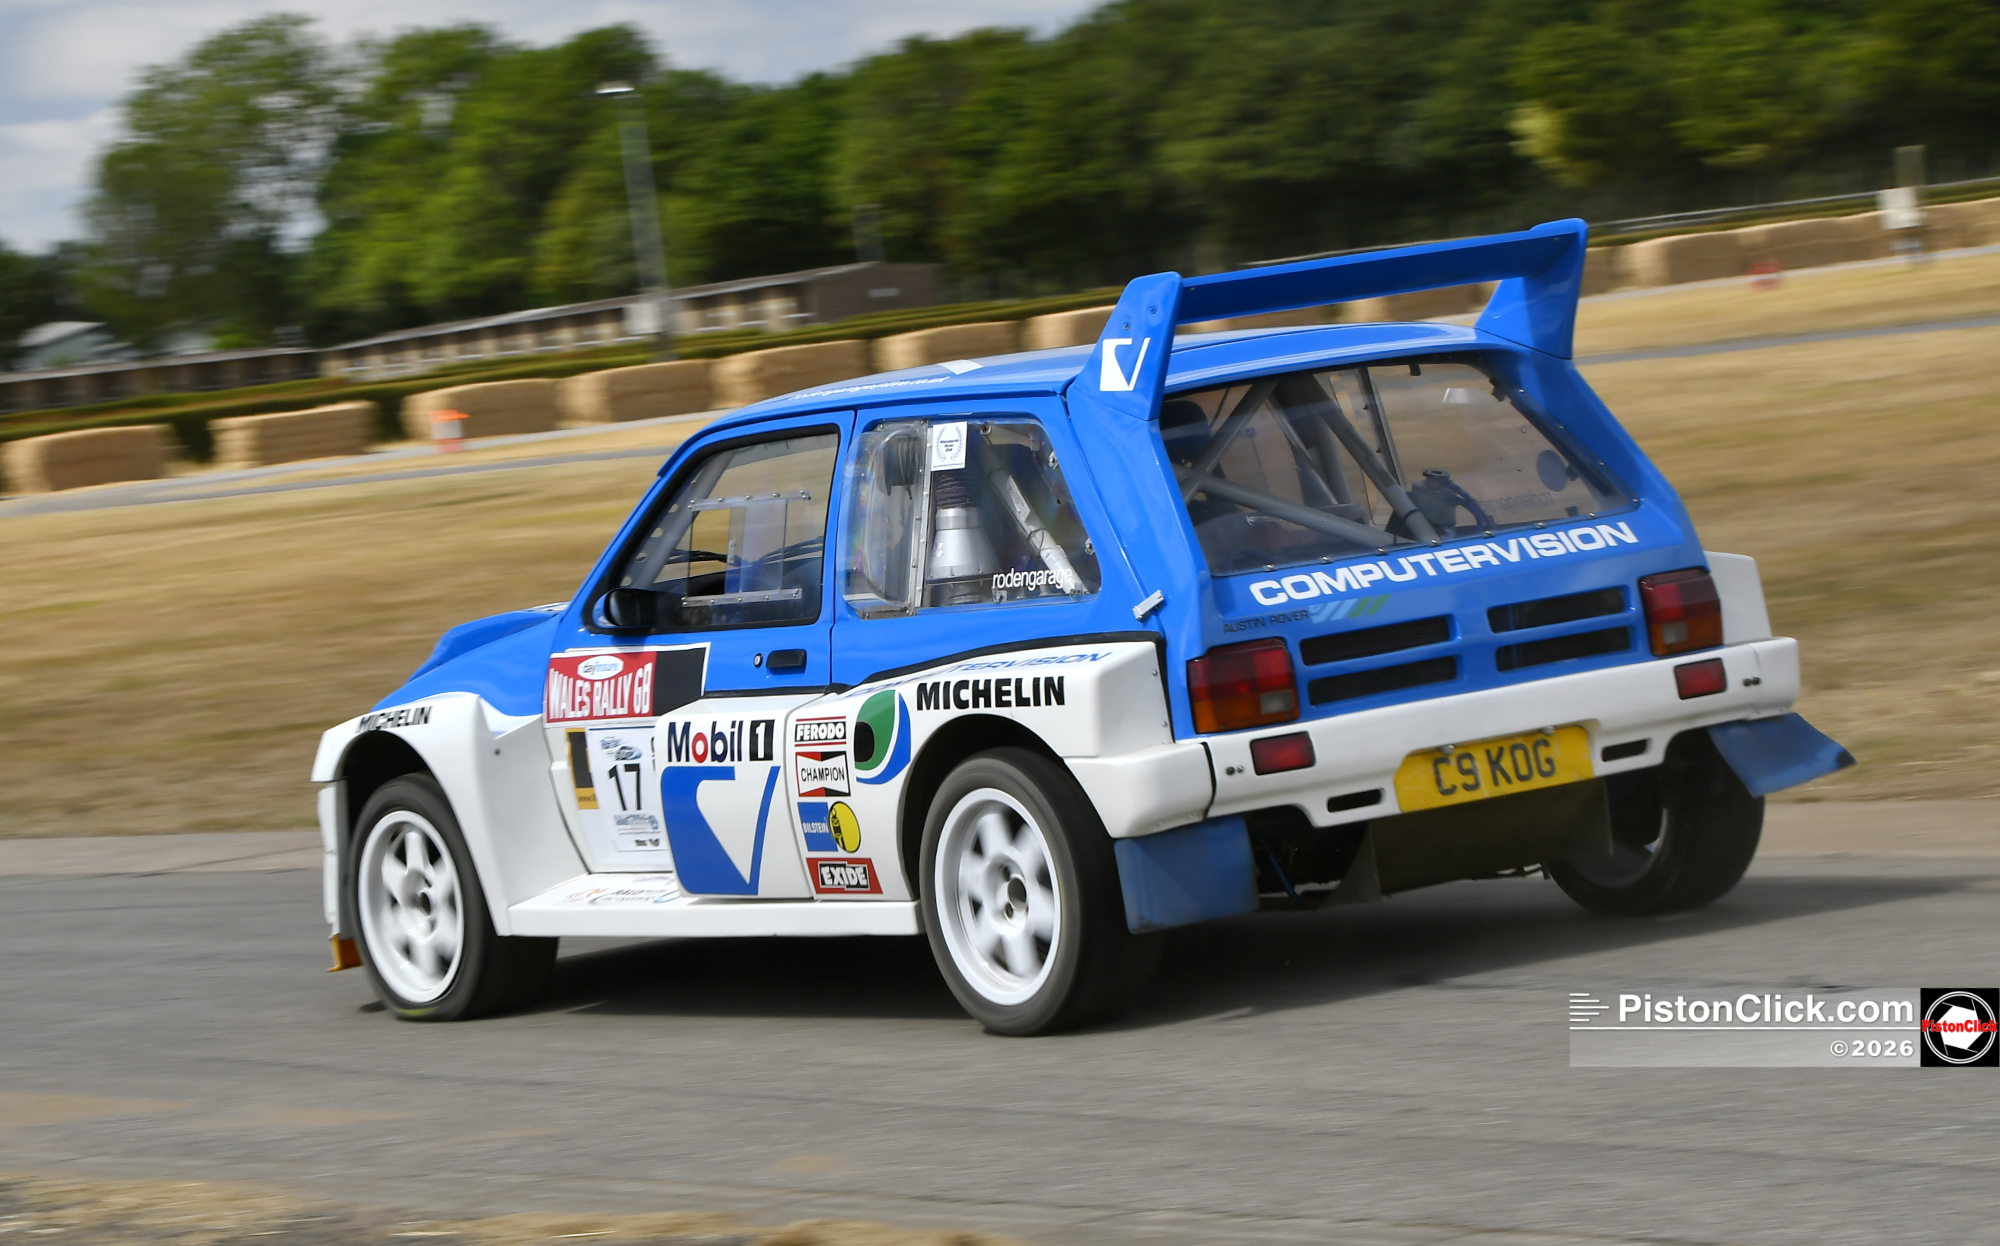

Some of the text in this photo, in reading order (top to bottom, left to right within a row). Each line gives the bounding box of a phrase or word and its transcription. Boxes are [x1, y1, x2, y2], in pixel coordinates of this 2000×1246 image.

[1249, 522, 1638, 605] COMPUTERVISION
[1223, 609, 1310, 634] AUSTIN ROVER
[549, 662, 653, 719] WALES RALLY GB
[916, 676, 1066, 711] MICHELIN
[355, 706, 433, 734] MICHELIN
[796, 722, 845, 741] FERODO
[667, 720, 744, 763] Mobil
[801, 767, 845, 782] CHAMPION
[1433, 738, 1556, 796] C9 KOG
[608, 763, 642, 811] 17
[803, 821, 829, 834] BILSTEIN
[820, 866, 869, 887] EXIDE
